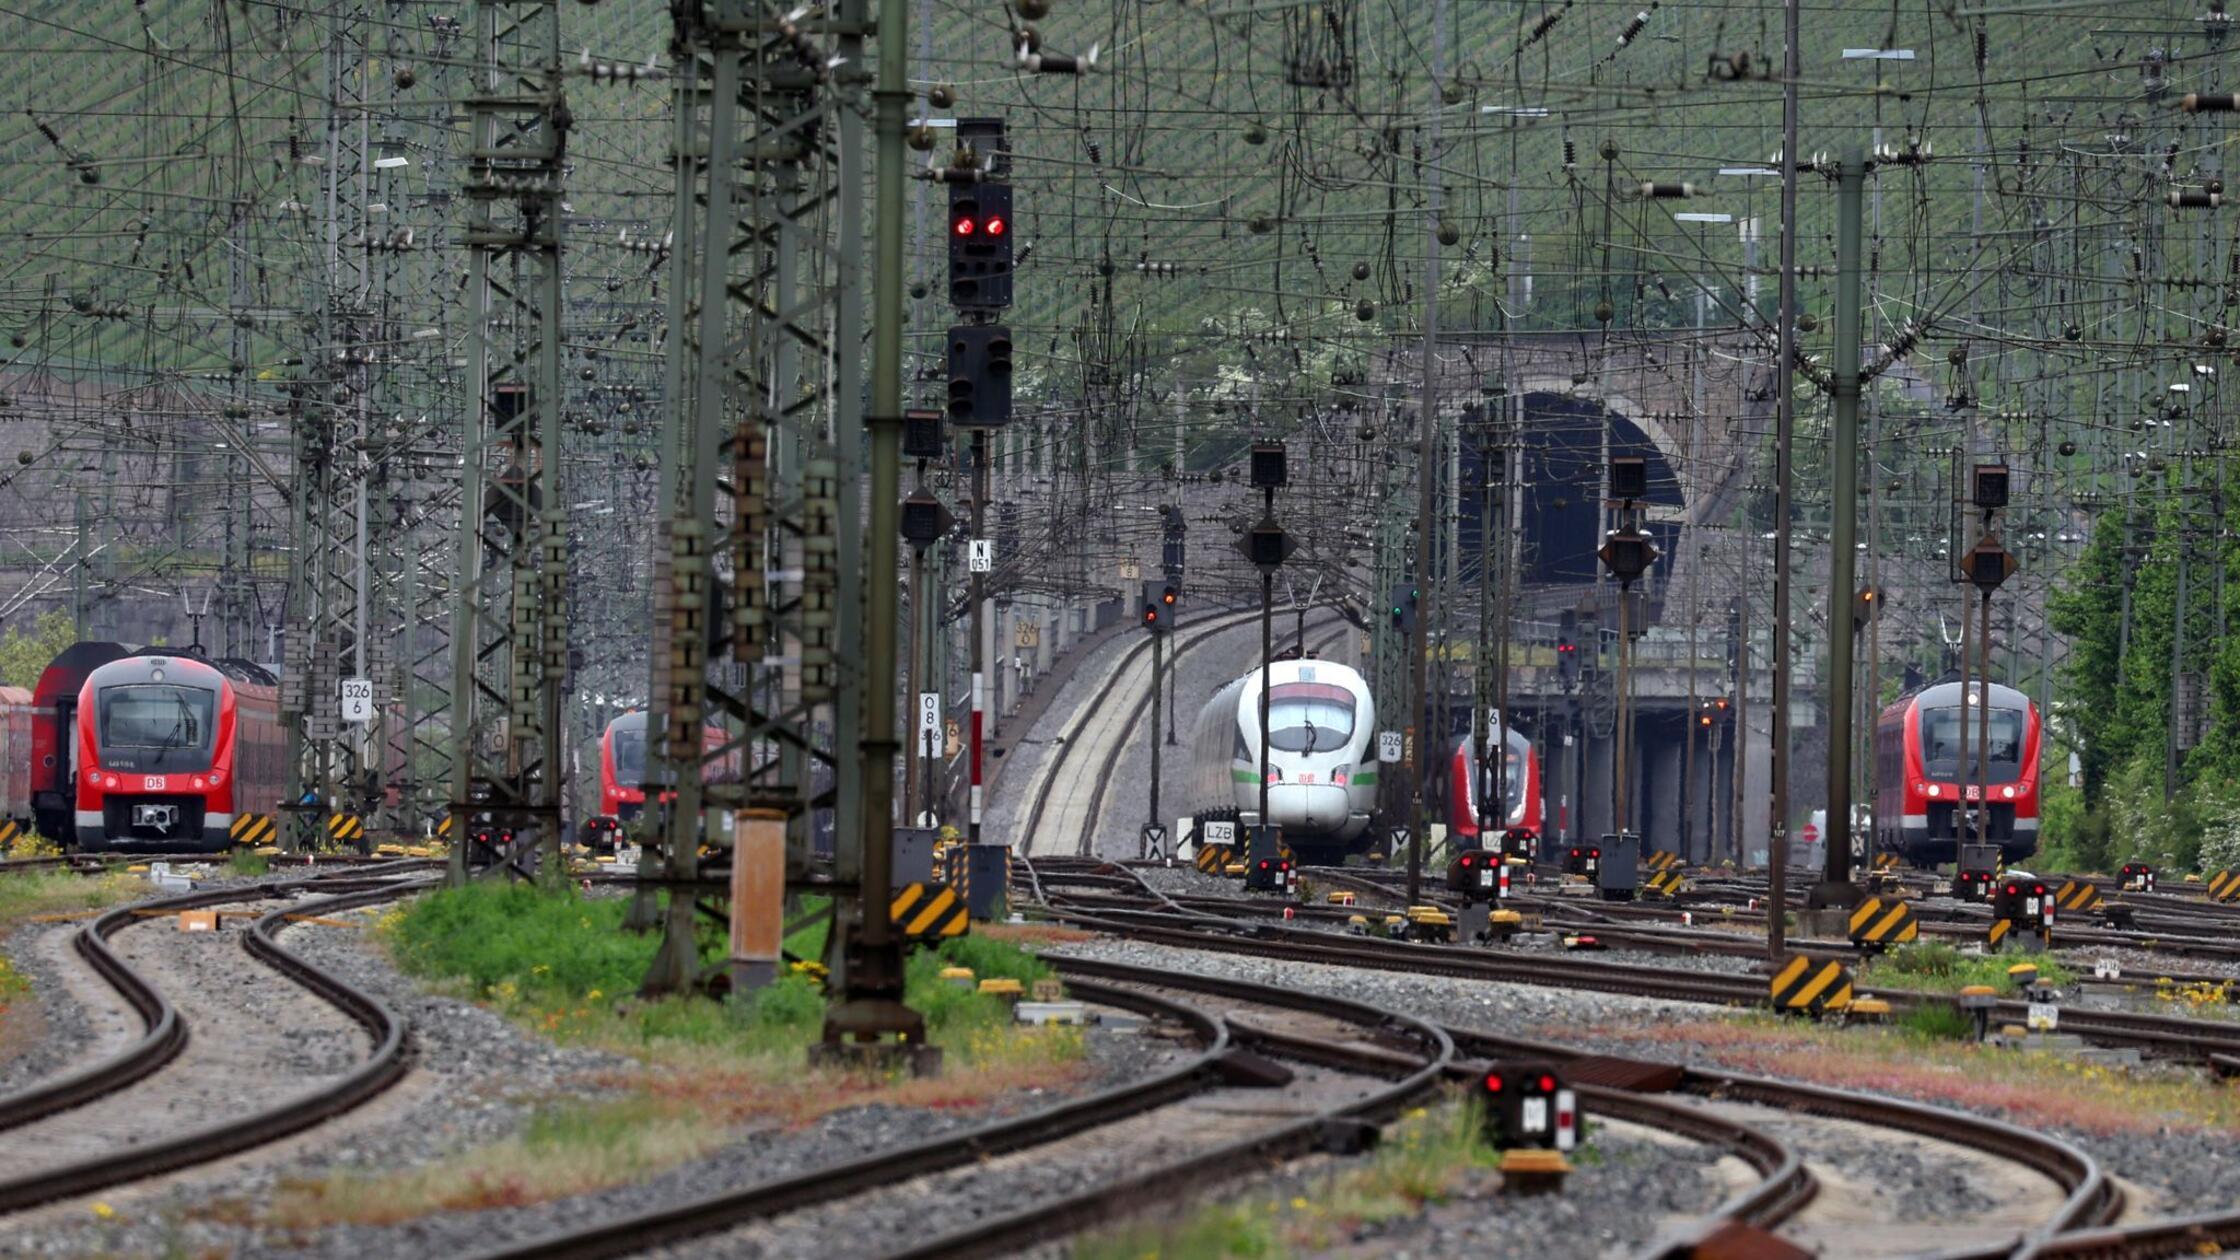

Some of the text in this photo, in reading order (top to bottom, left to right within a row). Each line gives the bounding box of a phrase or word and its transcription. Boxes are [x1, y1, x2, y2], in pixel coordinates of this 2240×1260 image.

[976, 542, 984, 558] N
[971, 558, 990, 570] 051
[345, 684, 370, 699] 326
[353, 700, 362, 714] 6
[925, 696, 935, 710] 0
[925, 711, 934, 725] 8
[921, 730, 942, 741] 36
[1381, 735, 1401, 746] 326
[1387, 747, 1395, 757] 4
[146, 777, 165, 789] DB
[1206, 825, 1233, 840] LZB
[1485, 836, 1502, 848] LZ
